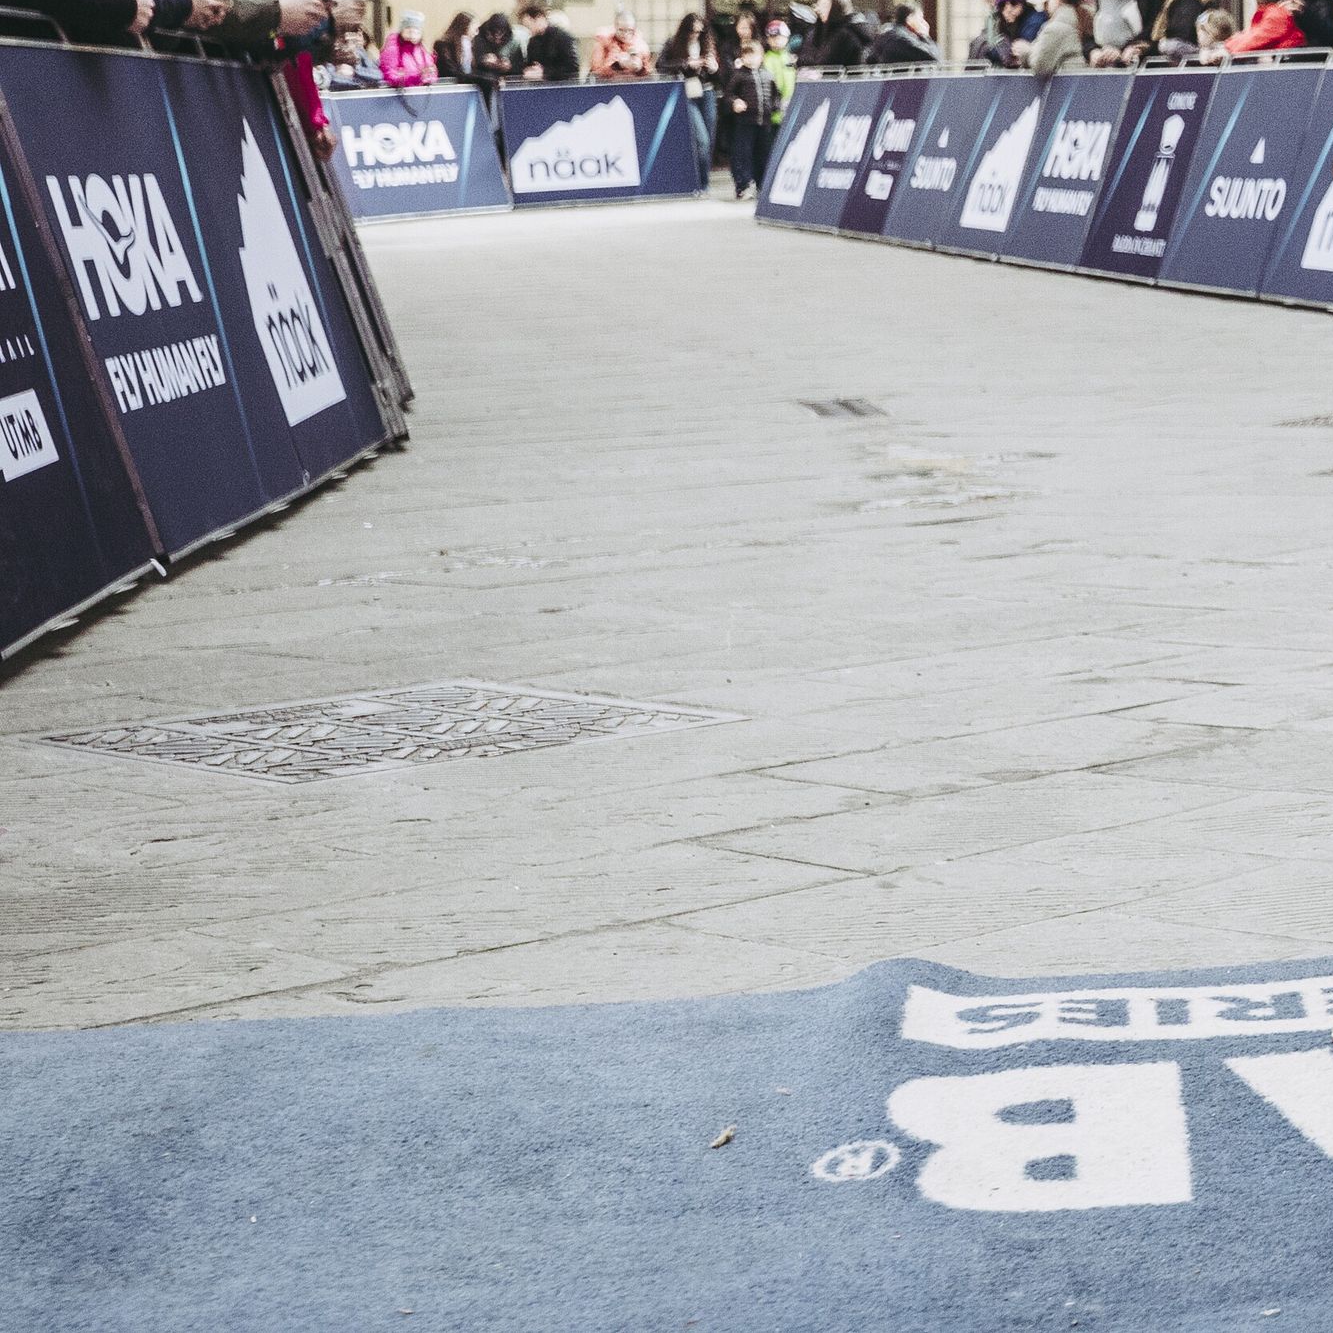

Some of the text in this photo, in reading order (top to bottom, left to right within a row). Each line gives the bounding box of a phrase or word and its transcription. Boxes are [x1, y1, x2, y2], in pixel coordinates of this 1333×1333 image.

[341, 120, 457, 166] HOKA
[528, 149, 625, 181] näak
[1205, 175, 1287, 220] SUUNTO
[46, 173, 202, 321] HOKA
[105, 334, 226, 414] FLY HUMAN FLY
[1, 409, 43, 460] UTMB
